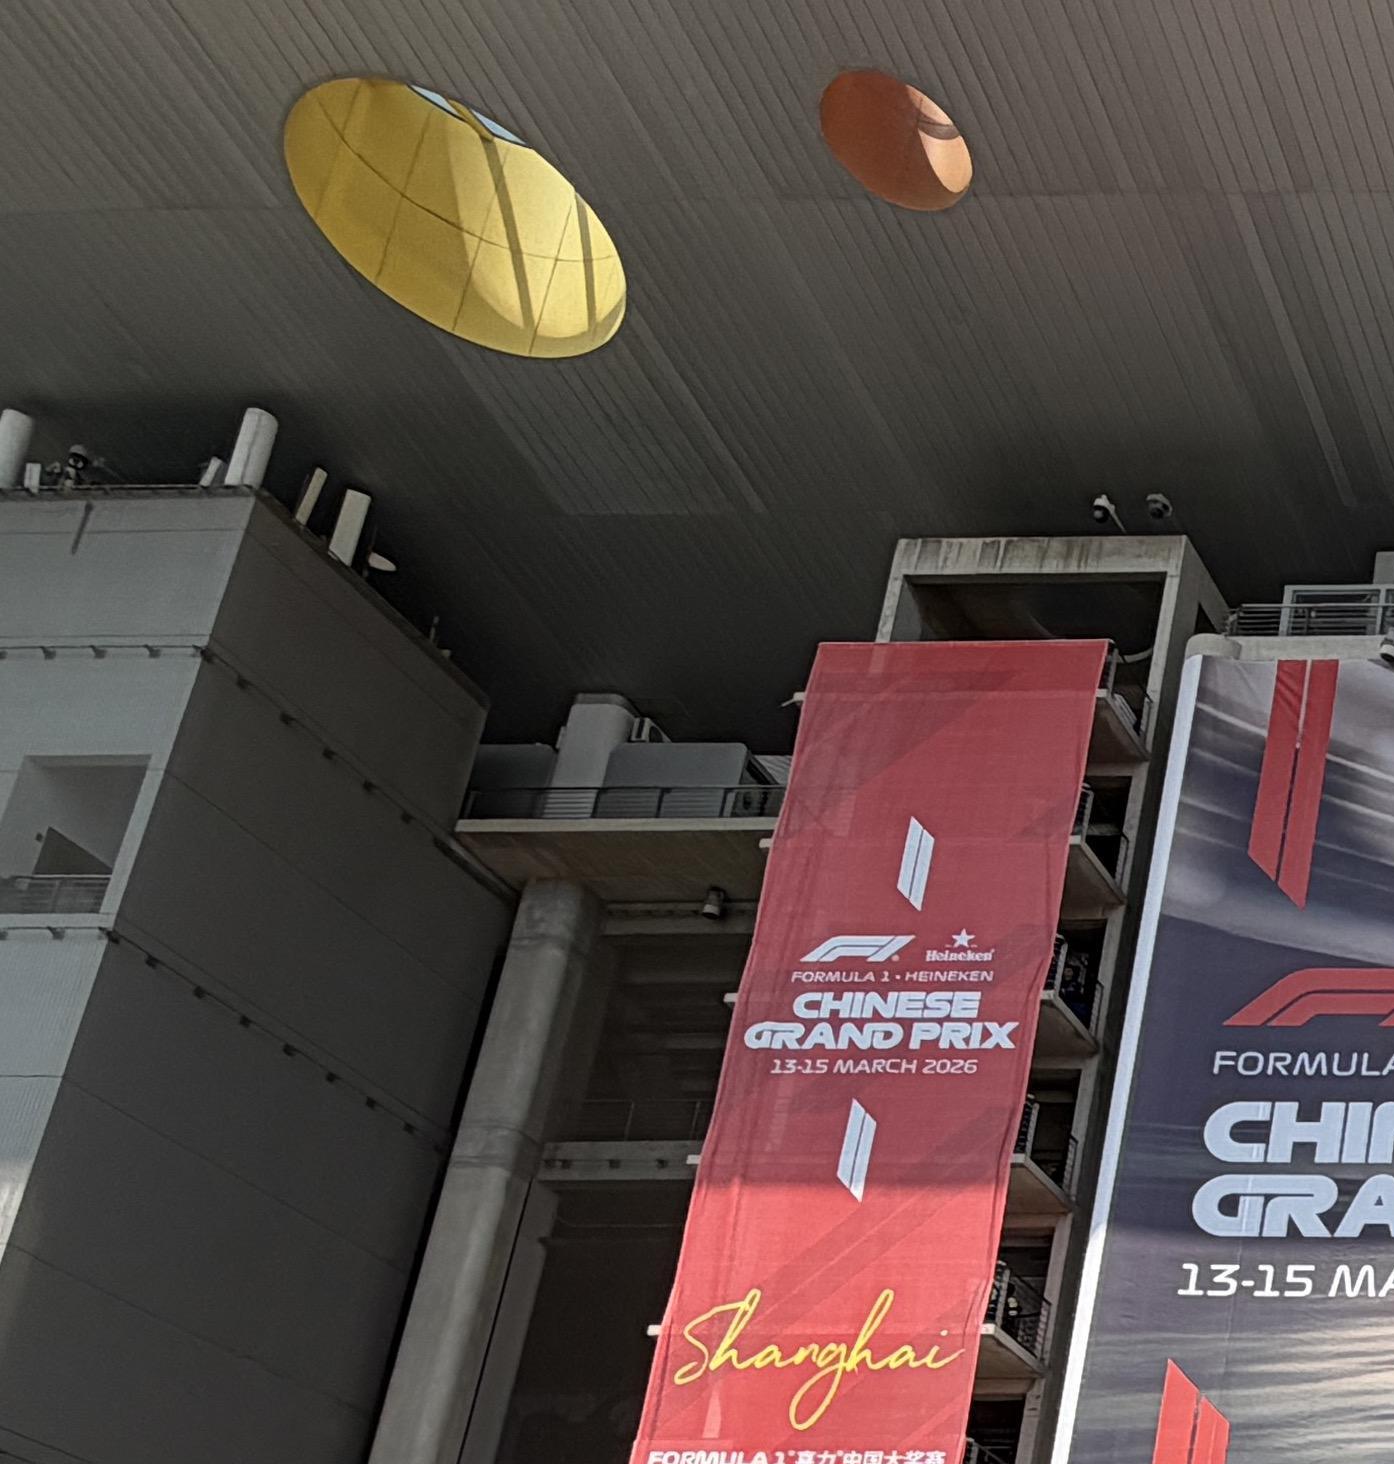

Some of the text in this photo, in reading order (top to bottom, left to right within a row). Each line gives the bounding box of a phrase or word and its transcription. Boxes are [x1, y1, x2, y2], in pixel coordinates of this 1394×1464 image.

[926, 949, 993, 962] Heineken
[791, 970, 994, 983] FORMULA 1 HEINEKEN
[793, 991, 982, 1018] CHINESE
[744, 1022, 1019, 1050] GRAND PRIX
[770, 1058, 978, 1074] 13-15 MARCH 2026
[1177, 1264, 1315, 1298] 13-15
[674, 1288, 966, 1431] Shanghai
